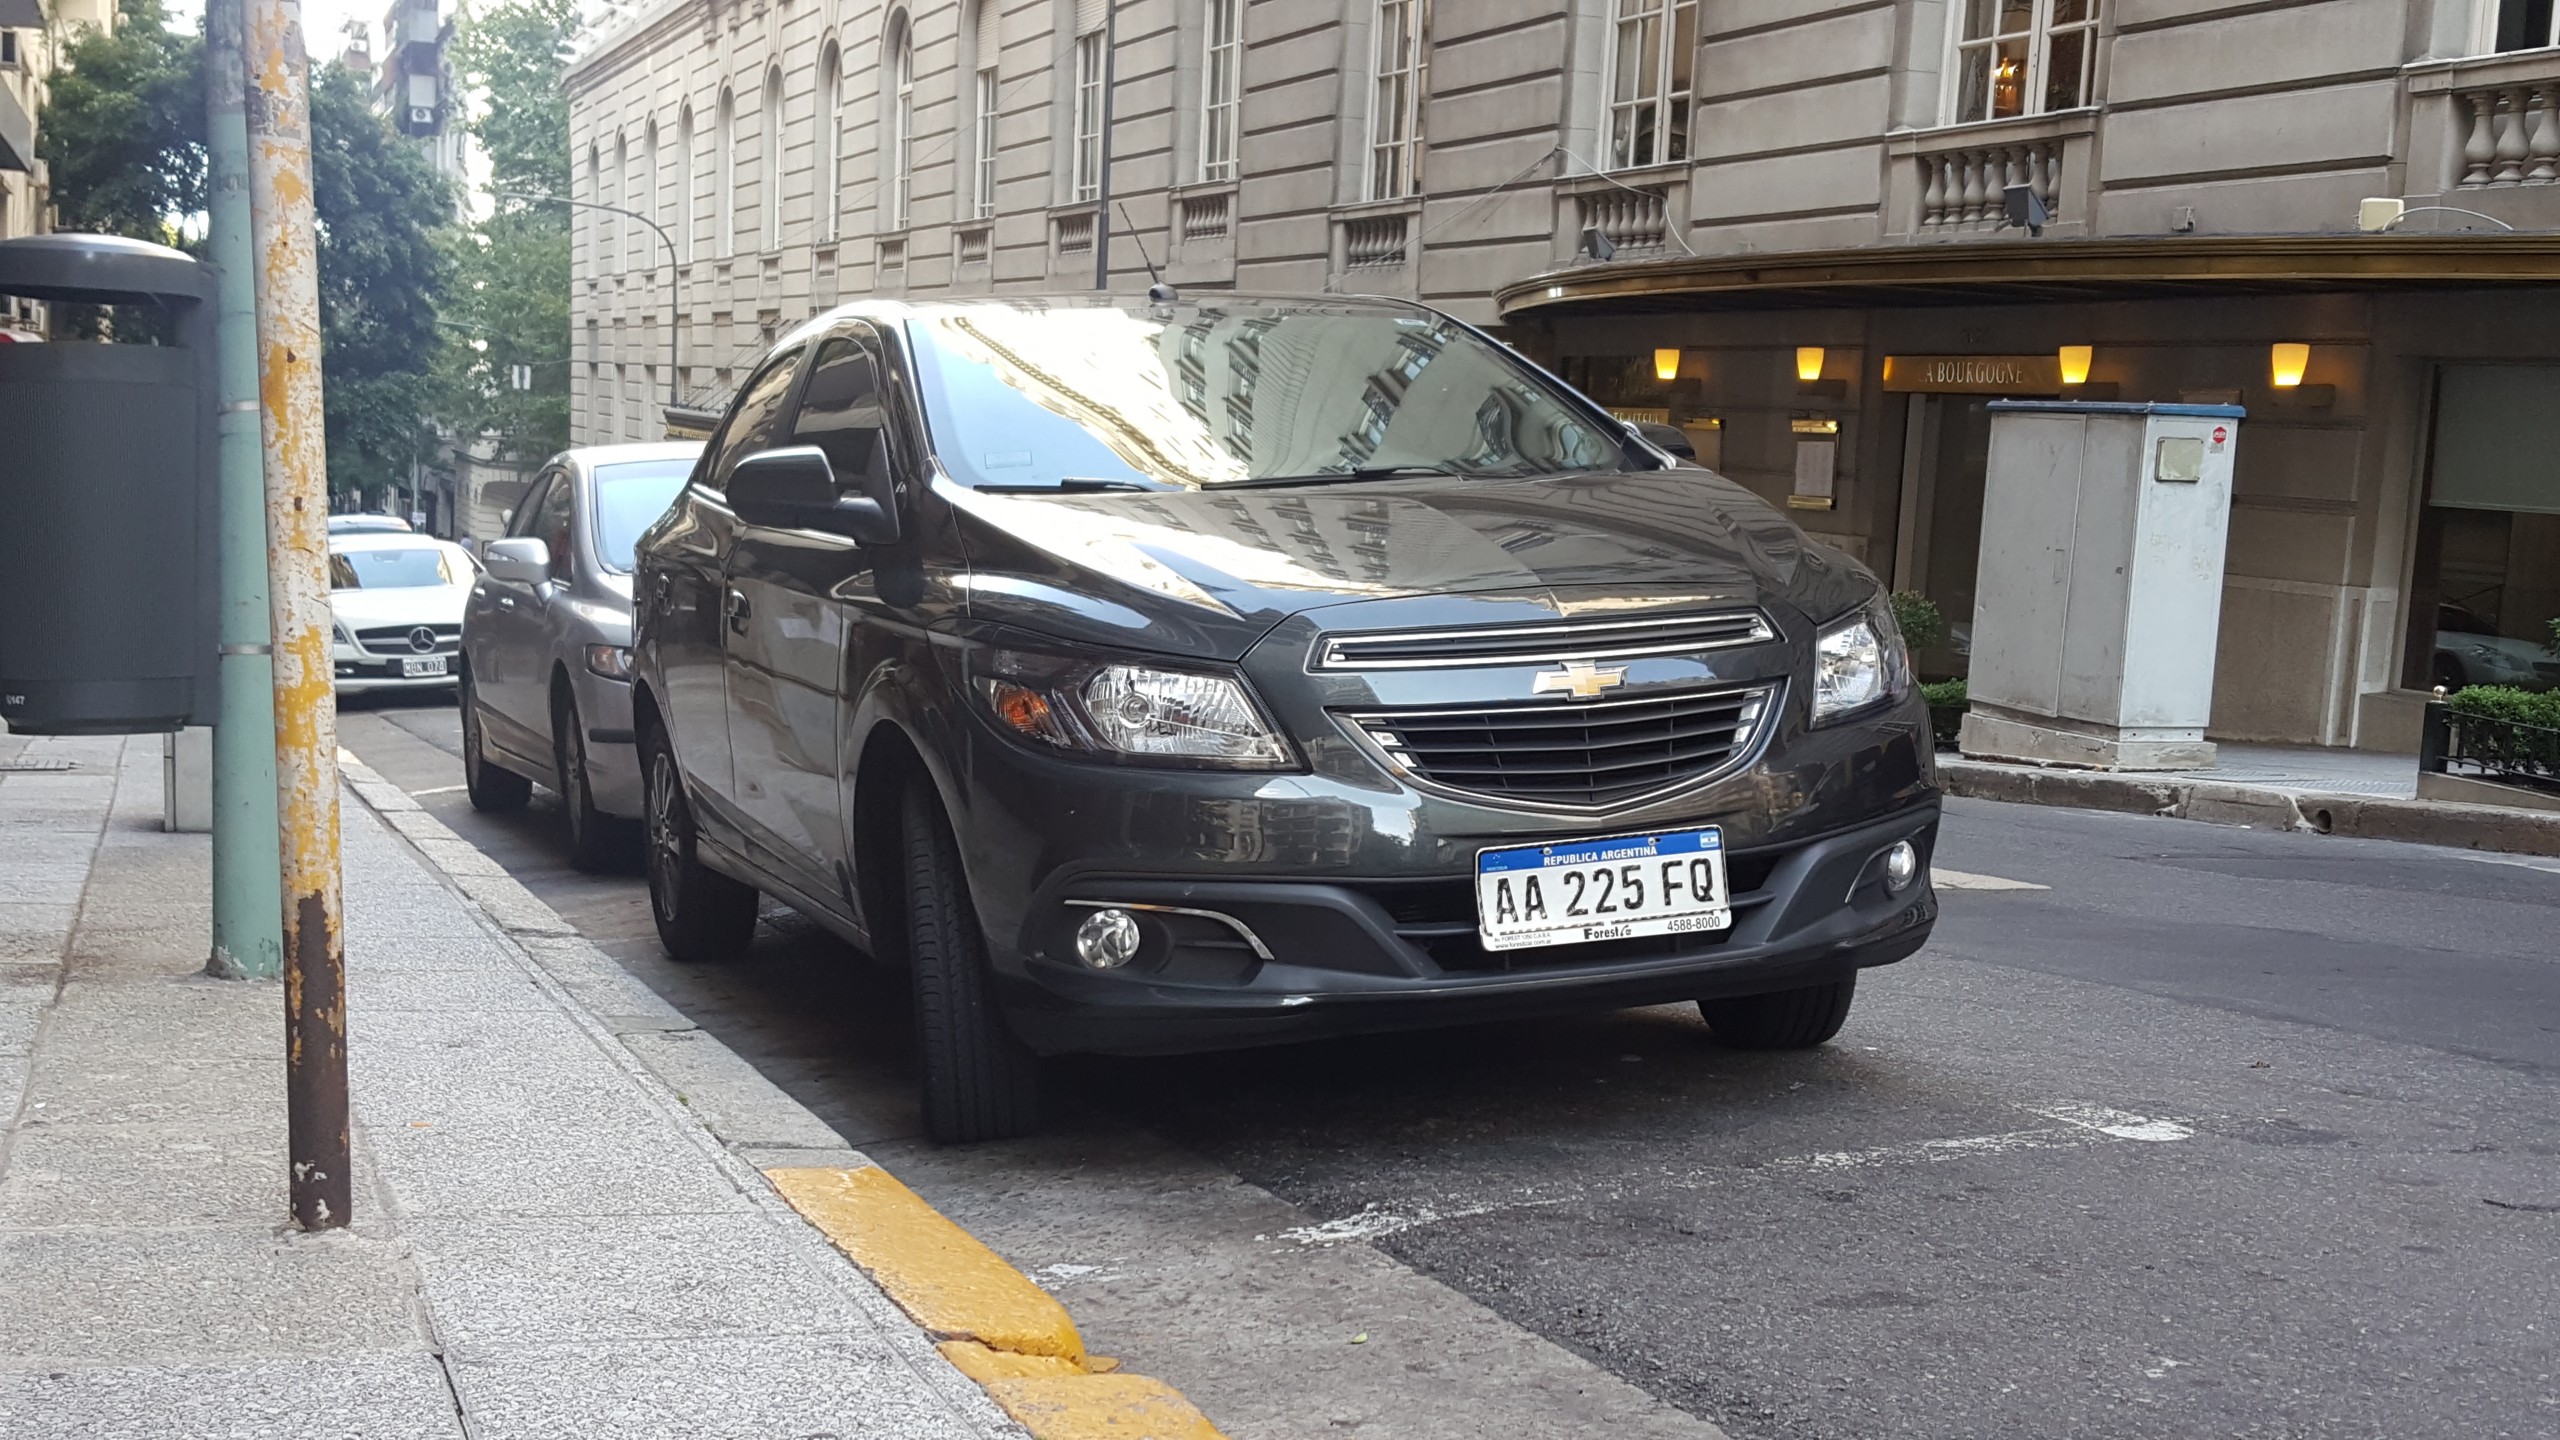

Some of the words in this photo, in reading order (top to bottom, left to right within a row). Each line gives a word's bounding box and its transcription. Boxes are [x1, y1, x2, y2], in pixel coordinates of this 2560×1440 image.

[1937, 362, 2022, 384] BOURGOGNE
[1544, 853, 1598, 866] REPUBLICA
[1601, 846, 1657, 861] ARGENTINA
[1496, 874, 1548, 924] AA
[1563, 865, 1645, 917] 225
[1661, 858, 1715, 906] FQ
[1667, 916, 1721, 932] 4588-8000
